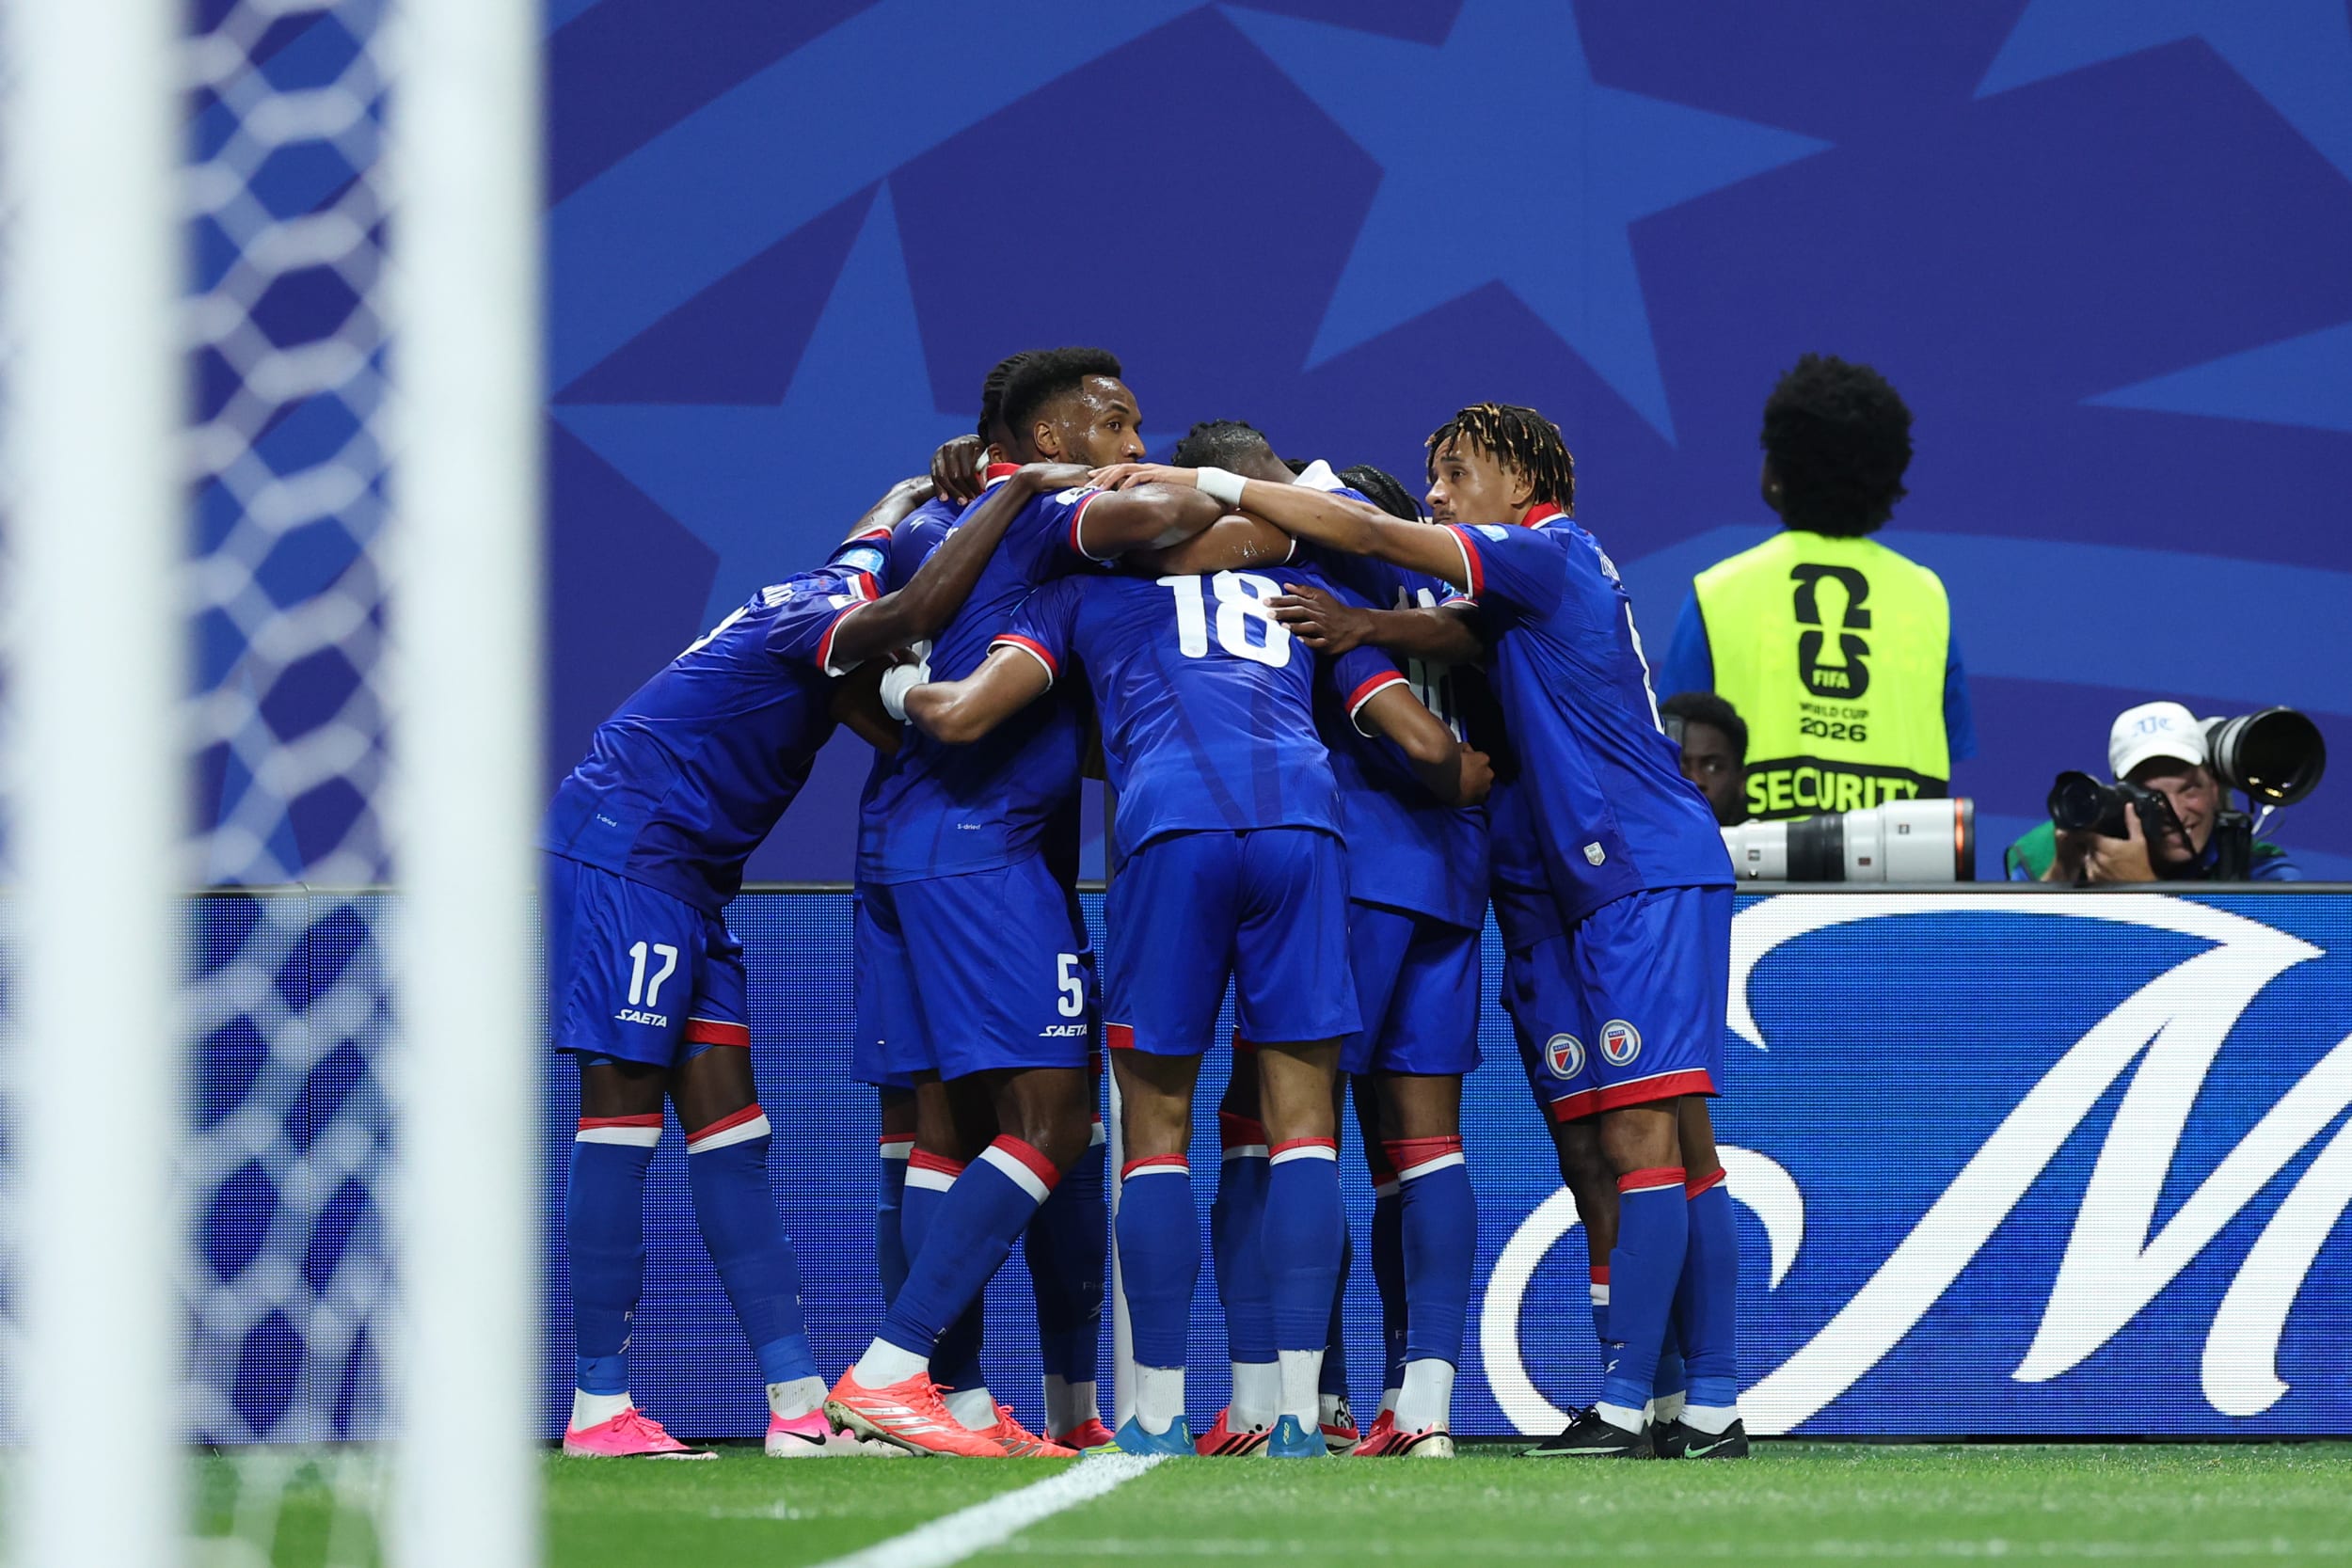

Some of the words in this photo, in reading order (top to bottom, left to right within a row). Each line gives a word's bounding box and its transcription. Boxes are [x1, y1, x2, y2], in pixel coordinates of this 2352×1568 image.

[1156, 569, 1291, 669] 18
[1812, 669, 1851, 689] FIFA
[1841, 706, 1869, 721] CUP
[1800, 717, 1867, 743] 2026
[628, 941, 678, 1007] 17
[1057, 953, 1084, 1018] 5
[614, 1008, 668, 1028] SAETA
[1038, 1023, 1088, 1037] SAETA
